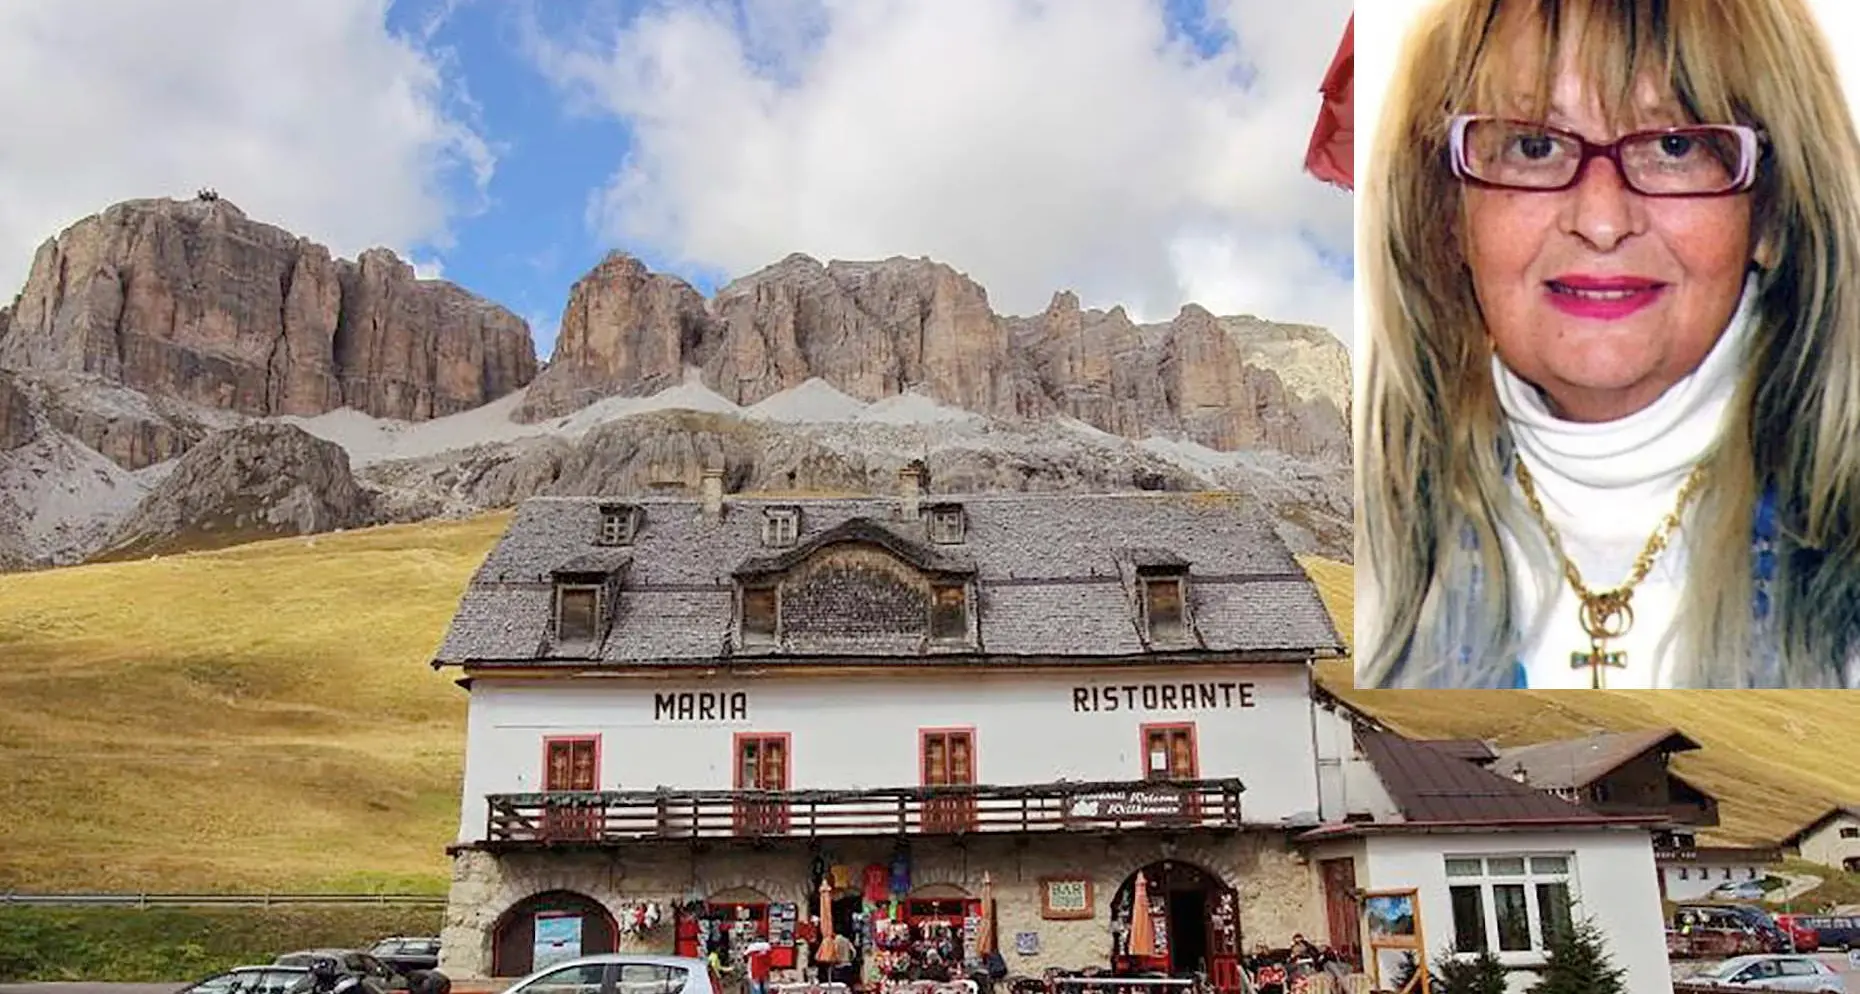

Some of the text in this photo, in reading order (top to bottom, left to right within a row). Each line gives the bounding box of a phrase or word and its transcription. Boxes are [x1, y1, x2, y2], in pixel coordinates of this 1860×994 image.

[654, 692, 747, 720] MARIA
[1072, 682, 1256, 712] RISTORANTE
[1051, 883, 1082, 896] BAR
